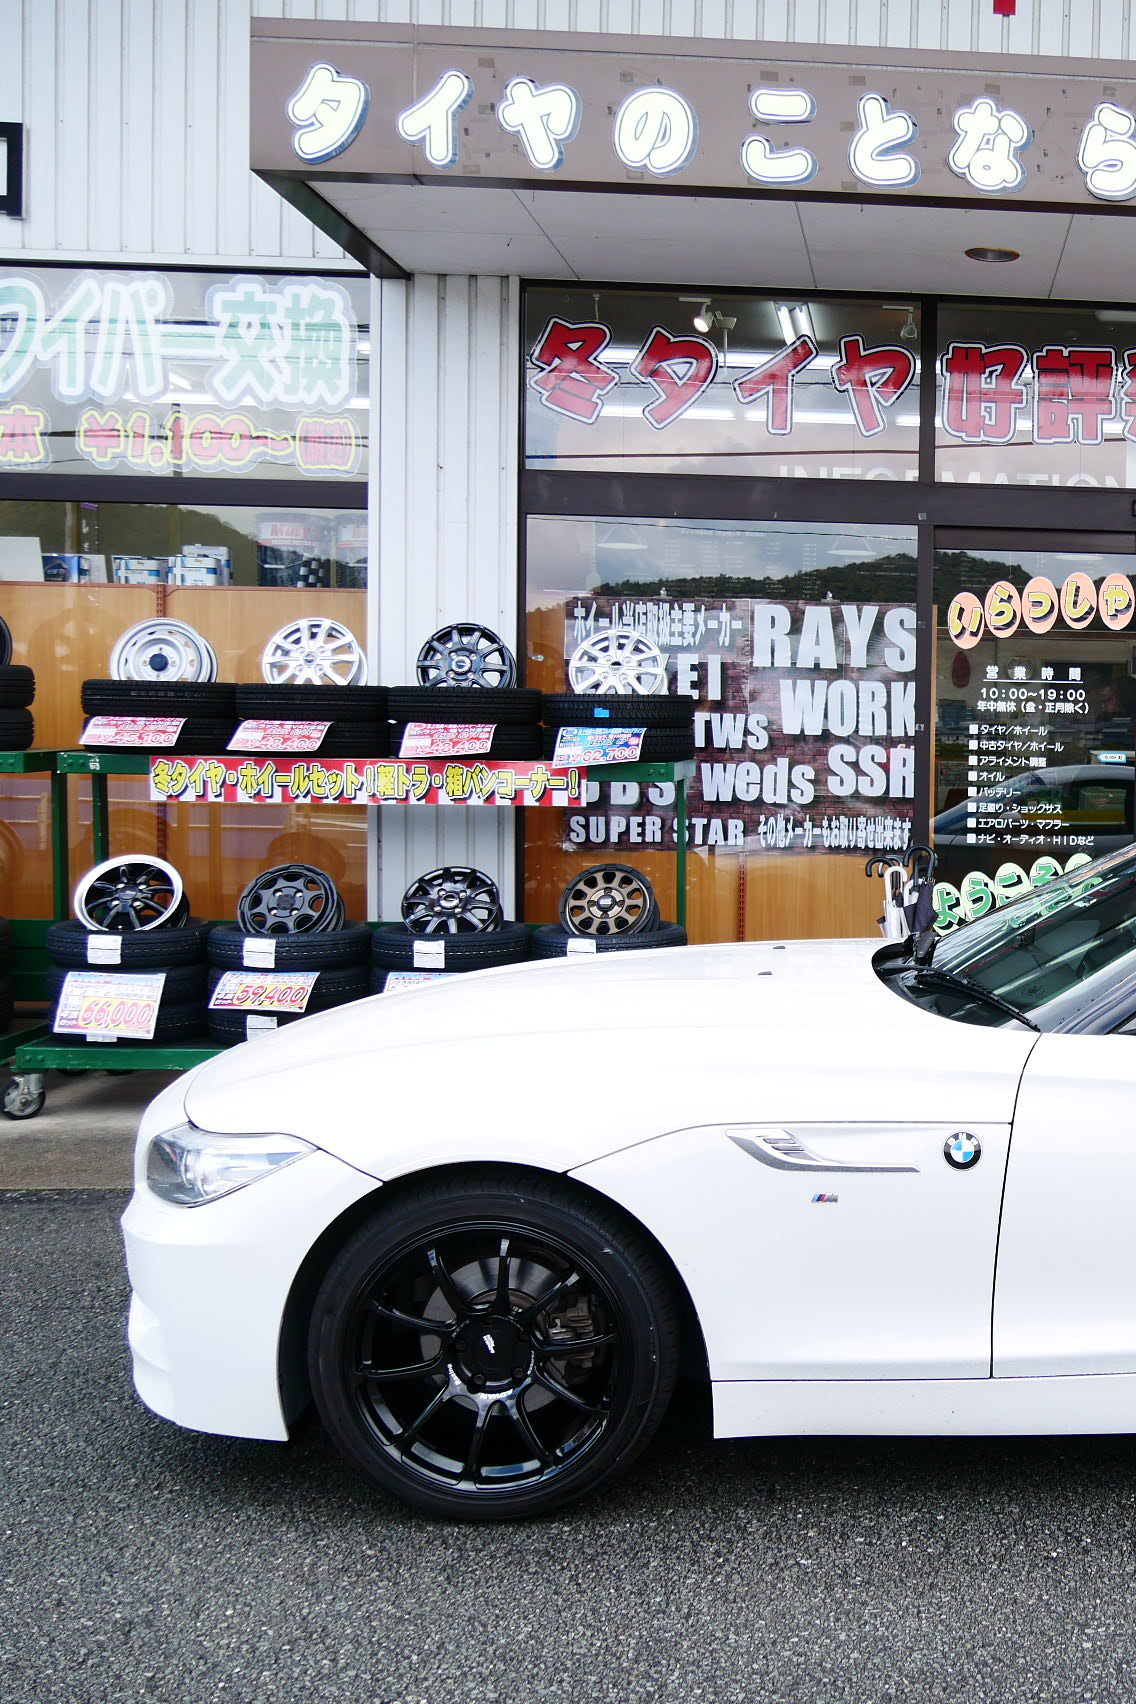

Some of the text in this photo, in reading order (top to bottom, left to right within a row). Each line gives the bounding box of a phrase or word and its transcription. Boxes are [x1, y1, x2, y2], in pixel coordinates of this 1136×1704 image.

[753, 604, 917, 673] RAYS
[986, 665, 1082, 681] 営業時間
[780, 678, 916, 738] WORK
[979, 771, 1006, 782] オイル
[979, 787, 1021, 798] バッテリー
[569, 815, 663, 844] SUPER
